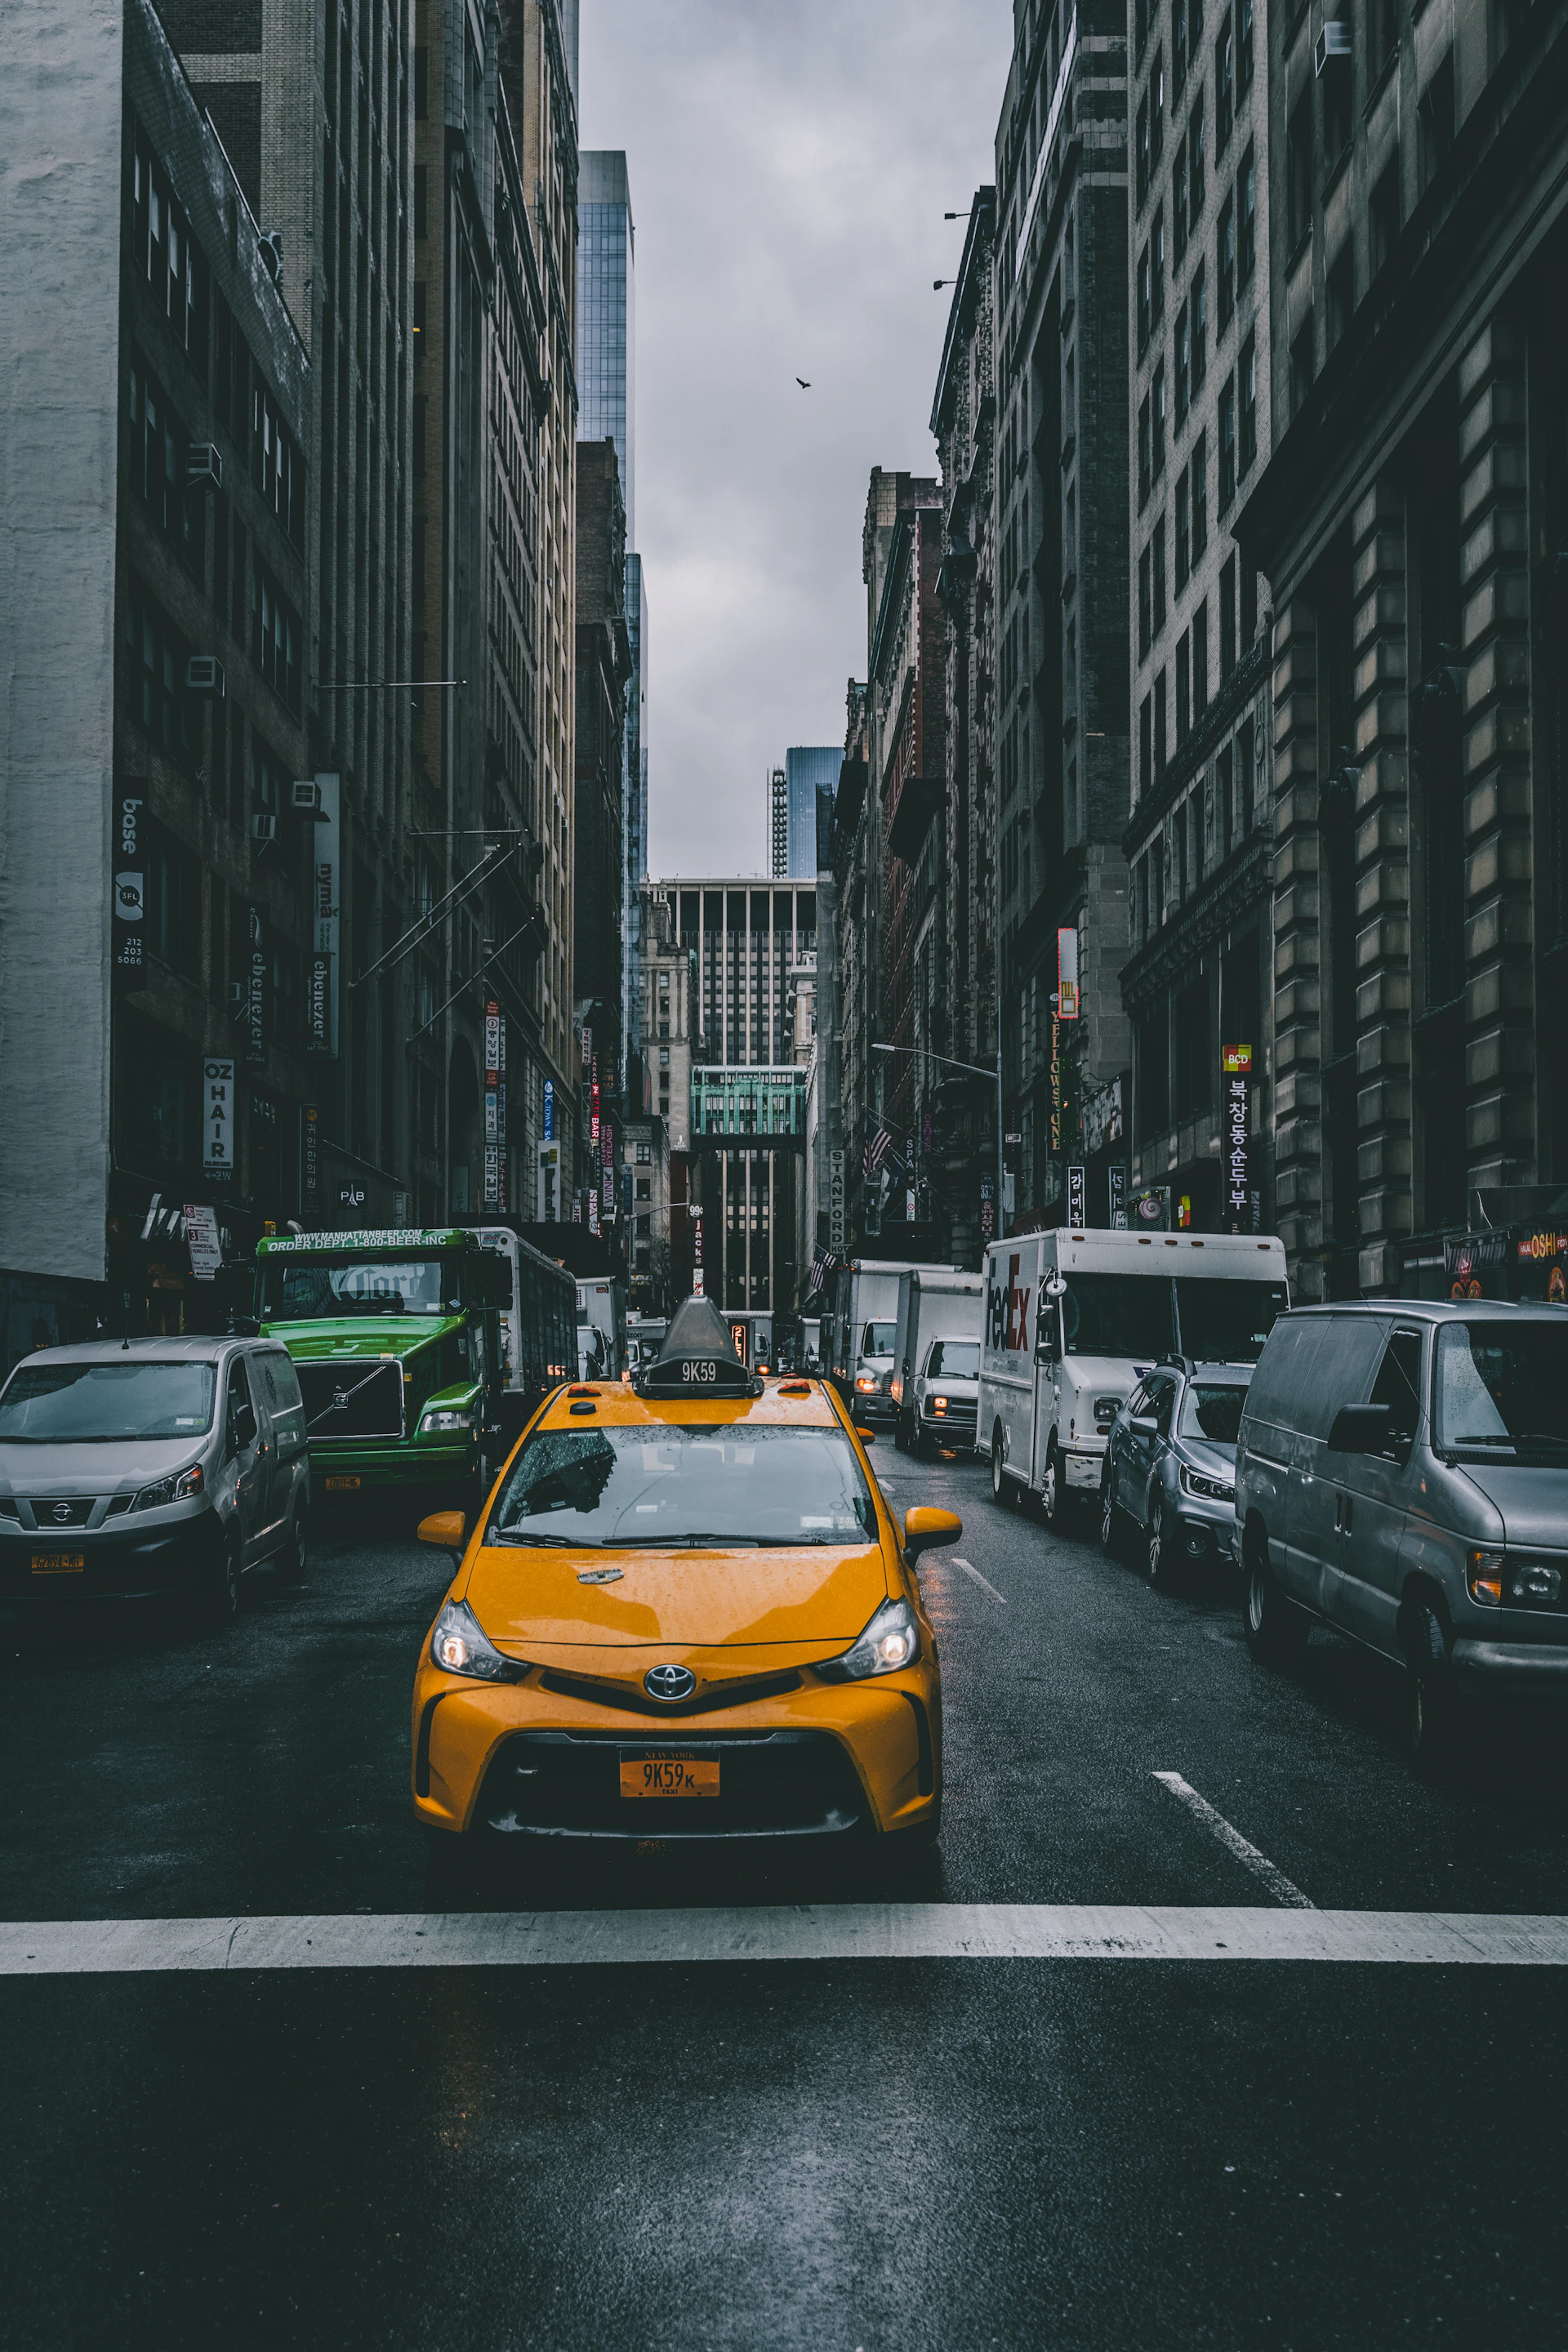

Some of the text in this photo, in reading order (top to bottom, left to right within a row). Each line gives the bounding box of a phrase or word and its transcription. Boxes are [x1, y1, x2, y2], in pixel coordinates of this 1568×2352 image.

[122, 798, 144, 854] base
[122, 893, 138, 901] 3FL
[124, 947, 142, 956] 203
[127, 938, 142, 947] 212
[118, 956, 142, 965] 5066
[252, 952, 266, 1049] ebenezer
[314, 960, 327, 1038] ebenezer
[488, 1030, 497, 1067] 중앙일보
[1227, 1054, 1249, 1064] BCD
[204, 1063, 232, 1080] OZ
[211, 1085, 225, 1158] HAIR
[544, 1094, 554, 1127] K-TOWN
[591, 1117, 599, 1138] BAR
[306, 1124, 316, 1188] 귀인한의원
[906, 1139, 915, 1169] SPA
[1228, 1080, 1249, 1210] 북창동순두부
[216, 1170, 232, 1181] 2W
[486, 1154, 497, 1200] 한국일보
[604, 1170, 613, 1204] WINK
[589, 1192, 598, 1217] SPA
[831, 1152, 844, 1243] STANFORD
[1070, 1173, 1083, 1227] 감미옥
[190, 1231, 197, 1241] 3
[268, 1235, 448, 1252] ORDER DEPT. 1-800-BEER-INC
[294, 1228, 424, 1242] WWW.MANHATTANBEER.COM
[694, 1220, 702, 1264] jacks
[1520, 1243, 1532, 1254] HALAL
[1531, 1232, 1556, 1258] OSHI
[985, 1254, 1031, 1352] FedEx
[682, 1361, 716, 1382] 9K59
